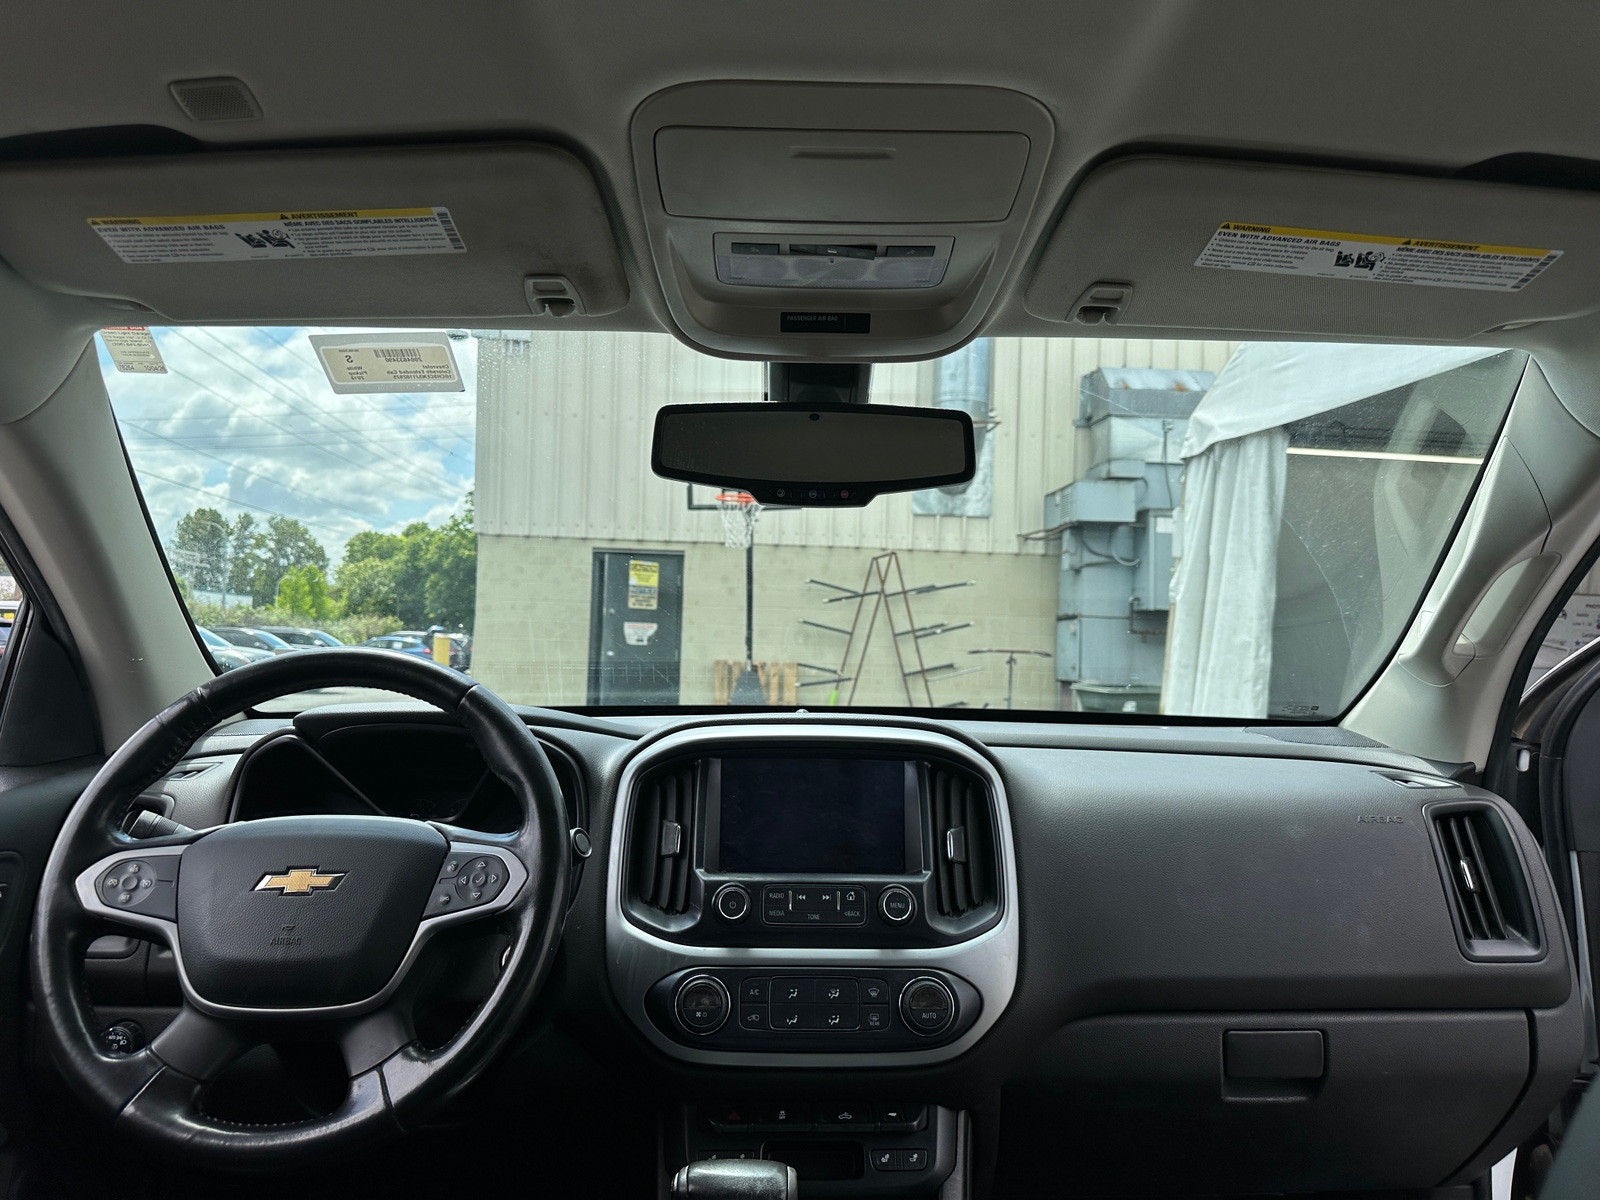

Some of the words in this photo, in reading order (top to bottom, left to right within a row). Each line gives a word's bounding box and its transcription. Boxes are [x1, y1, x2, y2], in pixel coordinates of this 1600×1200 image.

[1232, 224, 1272, 234] WARNING
[1261, 235, 1302, 244] ADVANCED
[1412, 240, 1479, 251] AVERTISSEMENT
[1357, 815, 1404, 823] AIRBAG
[270, 937, 302, 945] AIRBAG
